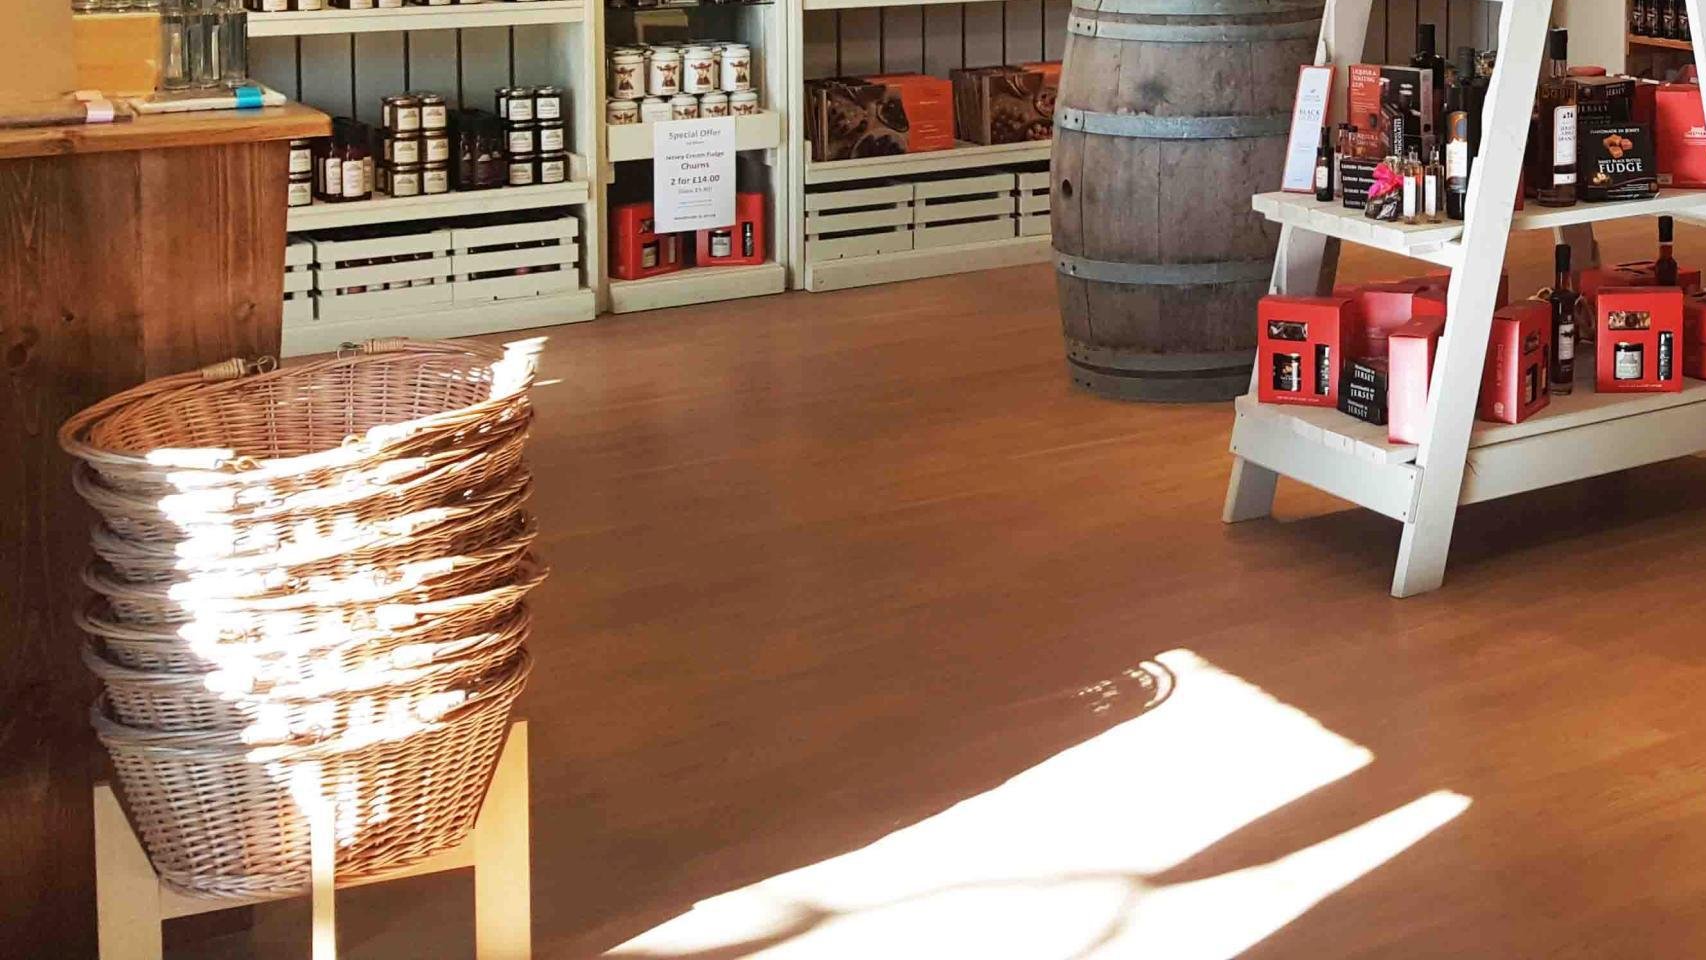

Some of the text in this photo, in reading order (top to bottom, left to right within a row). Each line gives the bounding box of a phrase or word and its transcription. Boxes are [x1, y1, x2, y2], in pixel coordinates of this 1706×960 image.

[668, 129, 721, 141] Special Offer
[681, 162, 710, 171] Churns
[1599, 162, 1643, 174] FUDGE
[670, 174, 720, 186] 2 for £14.00
[1354, 369, 1375, 383] JERSEY
[1350, 388, 1375, 401] JERSEY
[1348, 404, 1368, 418] JERSEY
